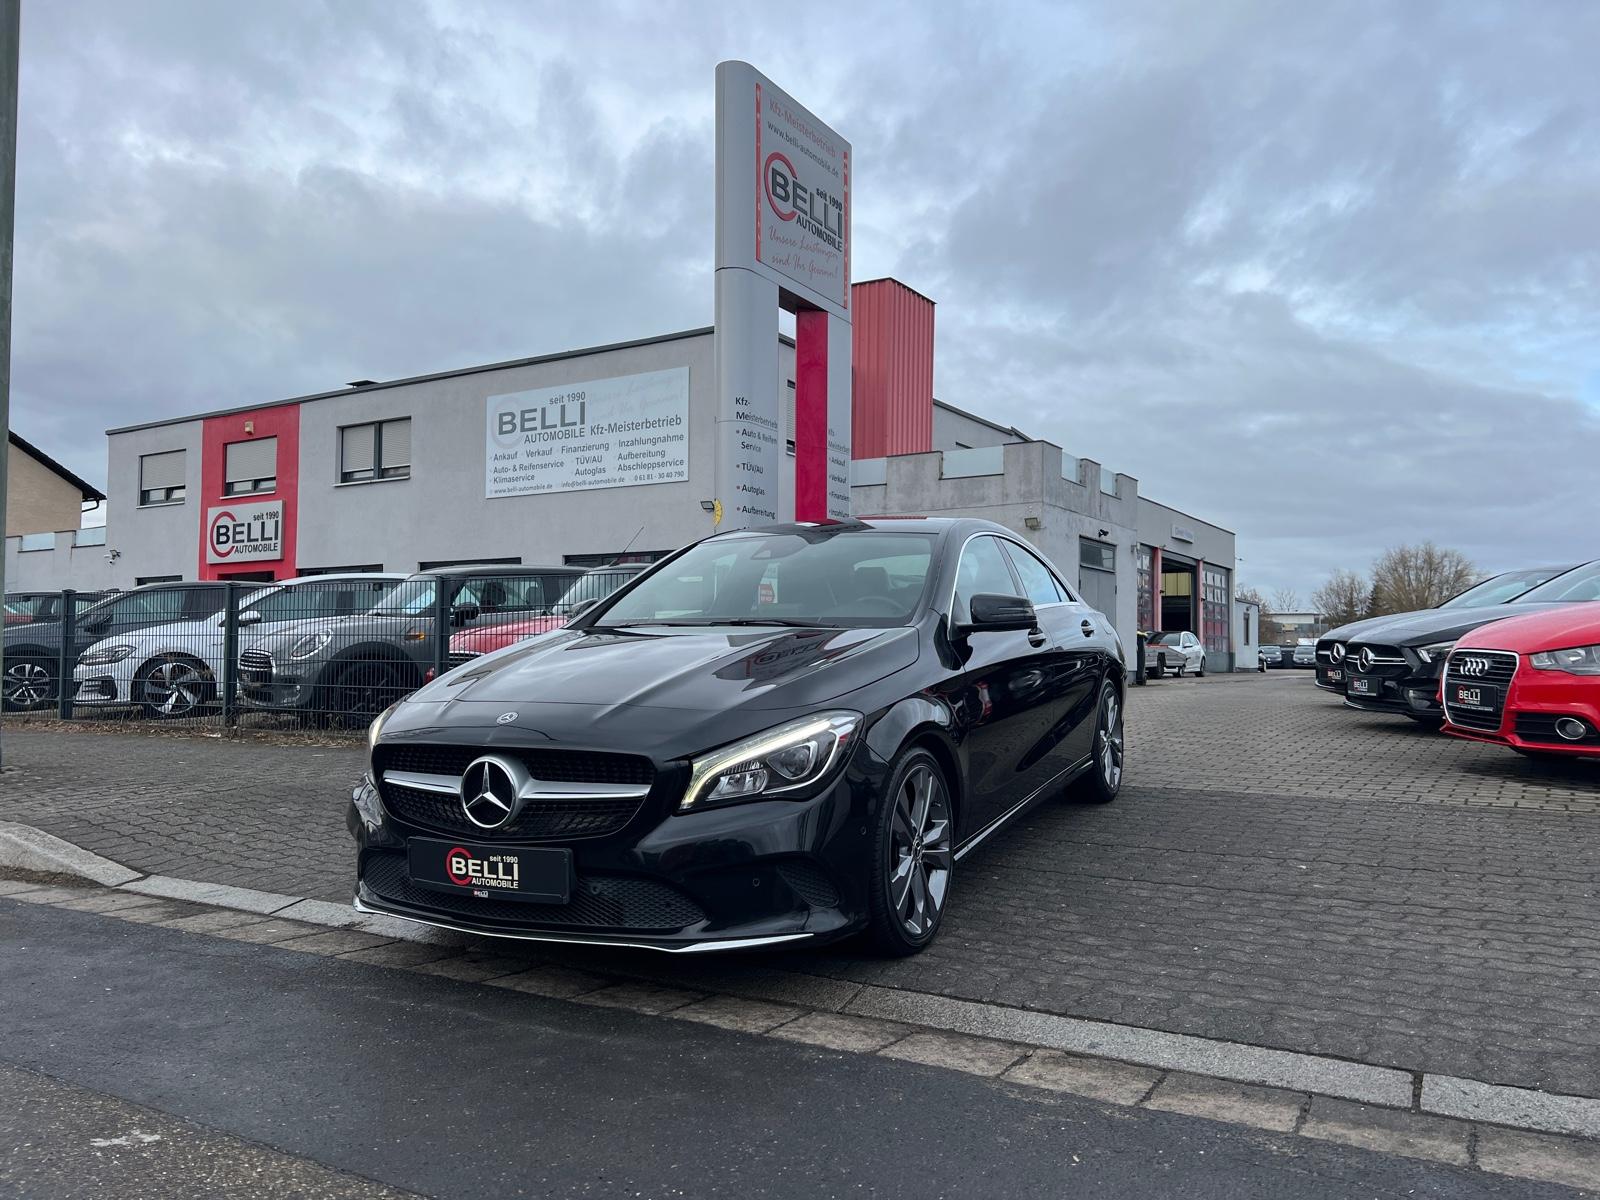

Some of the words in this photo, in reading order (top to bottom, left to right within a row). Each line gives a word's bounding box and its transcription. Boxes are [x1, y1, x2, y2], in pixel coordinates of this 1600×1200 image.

[769, 99, 836, 158] Kfz-Meisterbetrieb
[771, 167, 843, 240] BELLI
[816, 188, 828, 202] seit
[829, 195, 843, 212] 1990
[796, 214, 843, 253] AUTOMOBILE
[549, 396, 564, 405] seit
[566, 391, 586, 403] 1990
[735, 397, 751, 407] Kfz-
[498, 401, 586, 436] BELLI
[590, 414, 682, 436] Kfz-Meisterbetrieb
[736, 411, 778, 429] Meisterbetrieb
[524, 427, 585, 445] AUTOMOBILE
[741, 428, 757, 439] Auto
[493, 451, 518, 462] Ankauf
[525, 447, 553, 458] Verkauf
[561, 442, 610, 455] Finanzierung
[618, 433, 685, 448] Inzahlungnahme
[576, 455, 603, 466] TÜV/AU
[618, 449, 666, 462] Aufbereitung
[493, 464, 511, 475] Auto-
[512, 464, 517, 473] &
[519, 460, 565, 472] Reifenservice
[617, 458, 685, 473] Abschleppservice
[741, 462, 764, 474] TÜV/AU
[493, 473, 535, 485] Klimaservice
[494, 484, 553, 495] www.belli-automobile.de
[253, 513, 264, 521] seit
[265, 511, 280, 520] 1990
[741, 506, 776, 520] Aufbereitung
[215, 519, 279, 546] BELLI
[234, 542, 278, 554] AUTOMOBILE
[1458, 690, 1480, 701] BELLI
[489, 855, 501, 863] seit
[503, 856, 518, 864] 1990
[451, 857, 519, 881] BELLI
[471, 876, 519, 889] AUTOMOBILE
